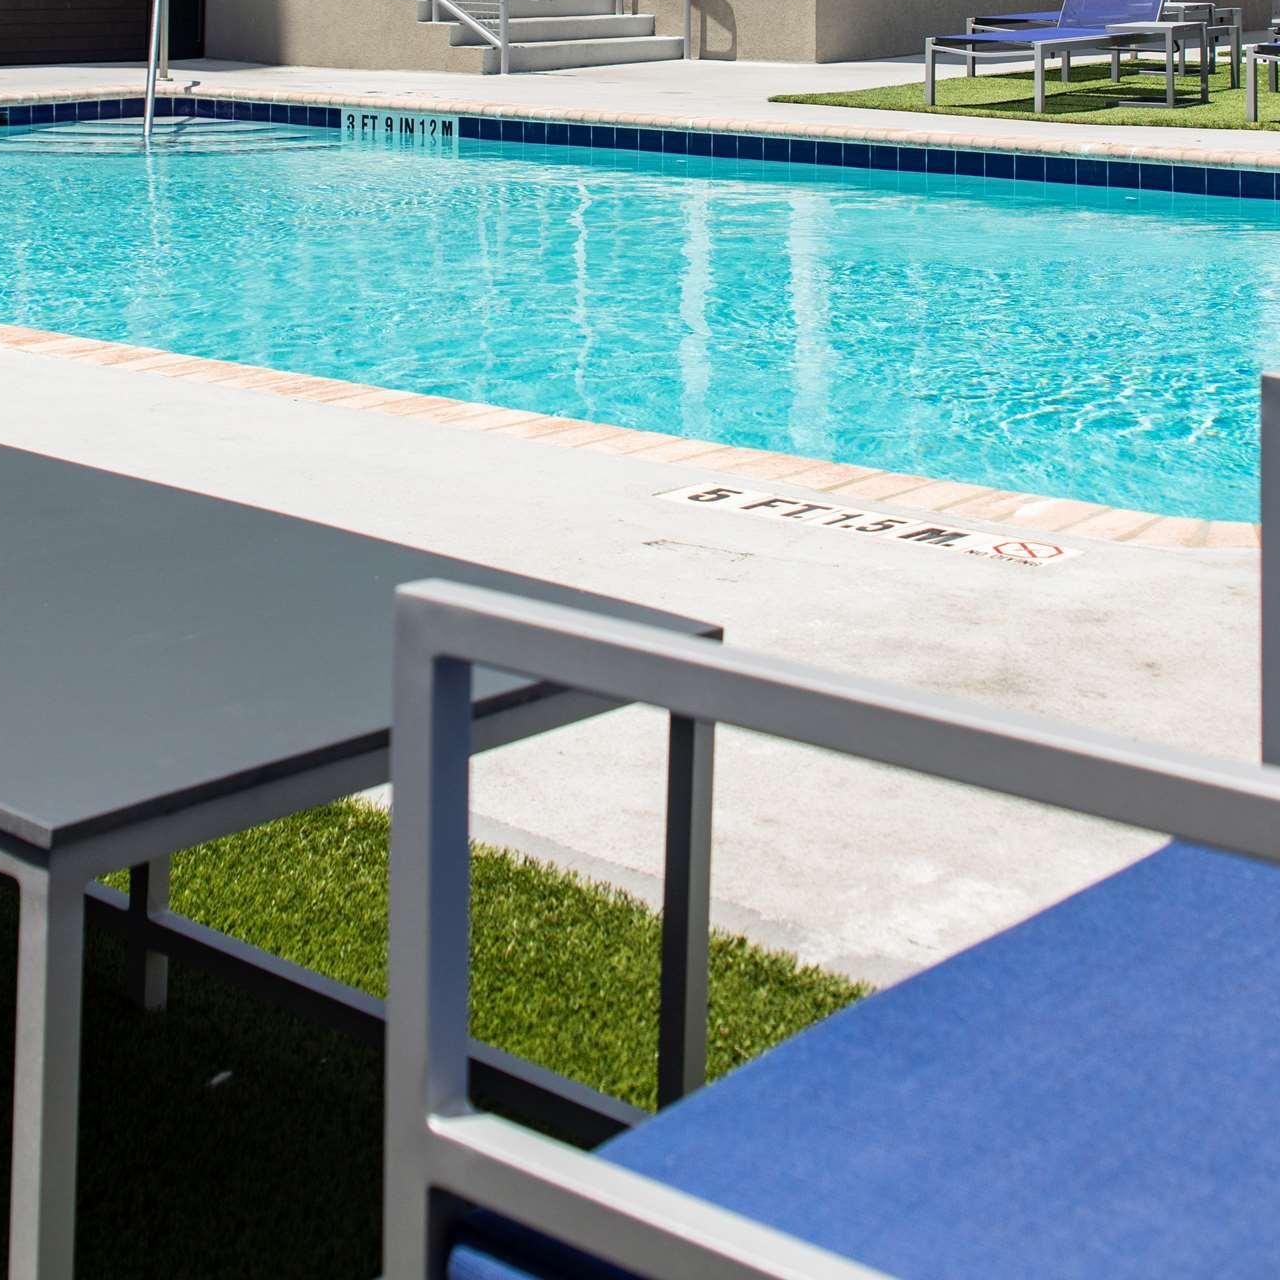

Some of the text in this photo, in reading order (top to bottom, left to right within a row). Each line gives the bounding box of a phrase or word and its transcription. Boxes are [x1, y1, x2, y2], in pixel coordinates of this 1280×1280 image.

[347, 114, 355, 130] 3
[361, 114, 378, 131] FT
[385, 116, 393, 133] 9
[400, 117, 415, 134] IN
[442, 120, 453, 137] M
[687, 487, 743, 502] 5
[822, 513, 909, 532] 1.5
